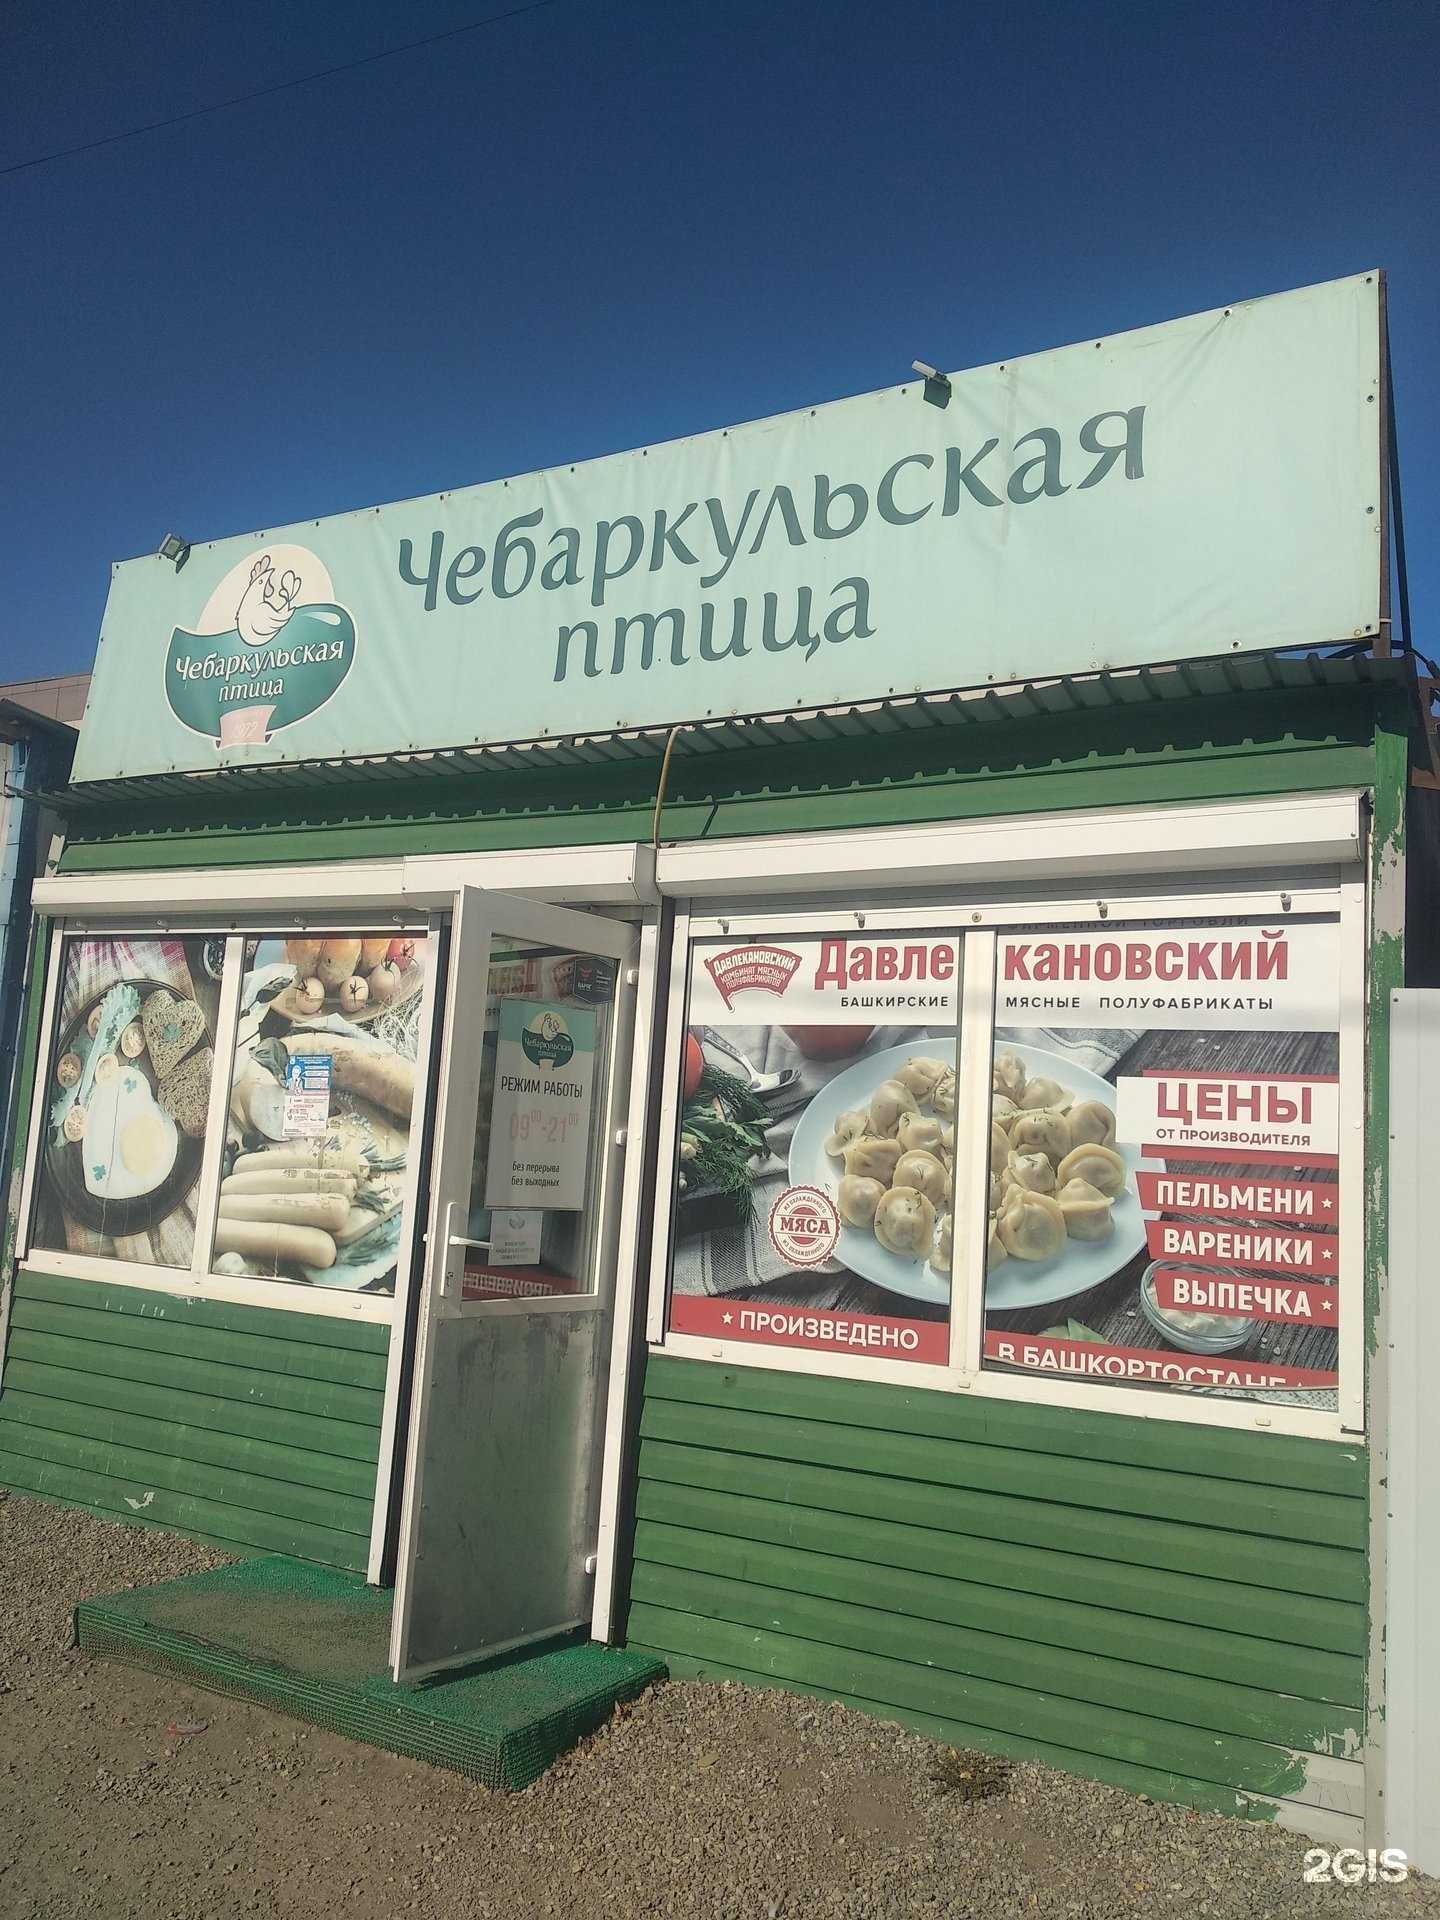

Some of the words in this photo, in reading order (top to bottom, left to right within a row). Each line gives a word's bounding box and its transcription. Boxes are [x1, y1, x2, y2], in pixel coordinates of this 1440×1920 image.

[399, 405, 1146, 611] Чебаркульская
[553, 577, 877, 682] птица
[176, 640, 344, 681] Чебаркульская
[218, 678, 284, 702] птица
[714, 950, 796, 976] ДАВЛЕКАНОВСКИЙ
[814, 938, 954, 990] Давле
[1004, 929, 1289, 982] кановский
[841, 996, 949, 1007] БАШКИРСКИЕ
[1006, 996, 1081, 1008] МЯСНЫЕ
[1099, 997, 1274, 1010] ПОЛУФАБРИКАТЫ
[501, 1075, 540, 1094] РЕЖИМ
[544, 1080, 583, 1098] РАБОТЫ
[1157, 1082, 1312, 1126] ЦЕНЫ
[1156, 1128, 1175, 1140] ОТ
[1179, 1129, 1311, 1147] ПРОИЗВОДИТЕЛЯ
[511, 1175, 523, 1186] без
[525, 1178, 560, 1188] выходных
[512, 1161, 525, 1172] без
[526, 1163, 560, 1174] перерыва
[1157, 1180, 1313, 1216] ПЕЛЬМЕНИ
[780, 1217, 830, 1234] МЯСА
[1164, 1228, 1313, 1266] ВАРЕНИКИ
[1173, 1278, 1312, 1317] ВЫПЕЧКА
[739, 1310, 919, 1350] ПРОИЗВЕДЕНО
[998, 1342, 1015, 1360] В
